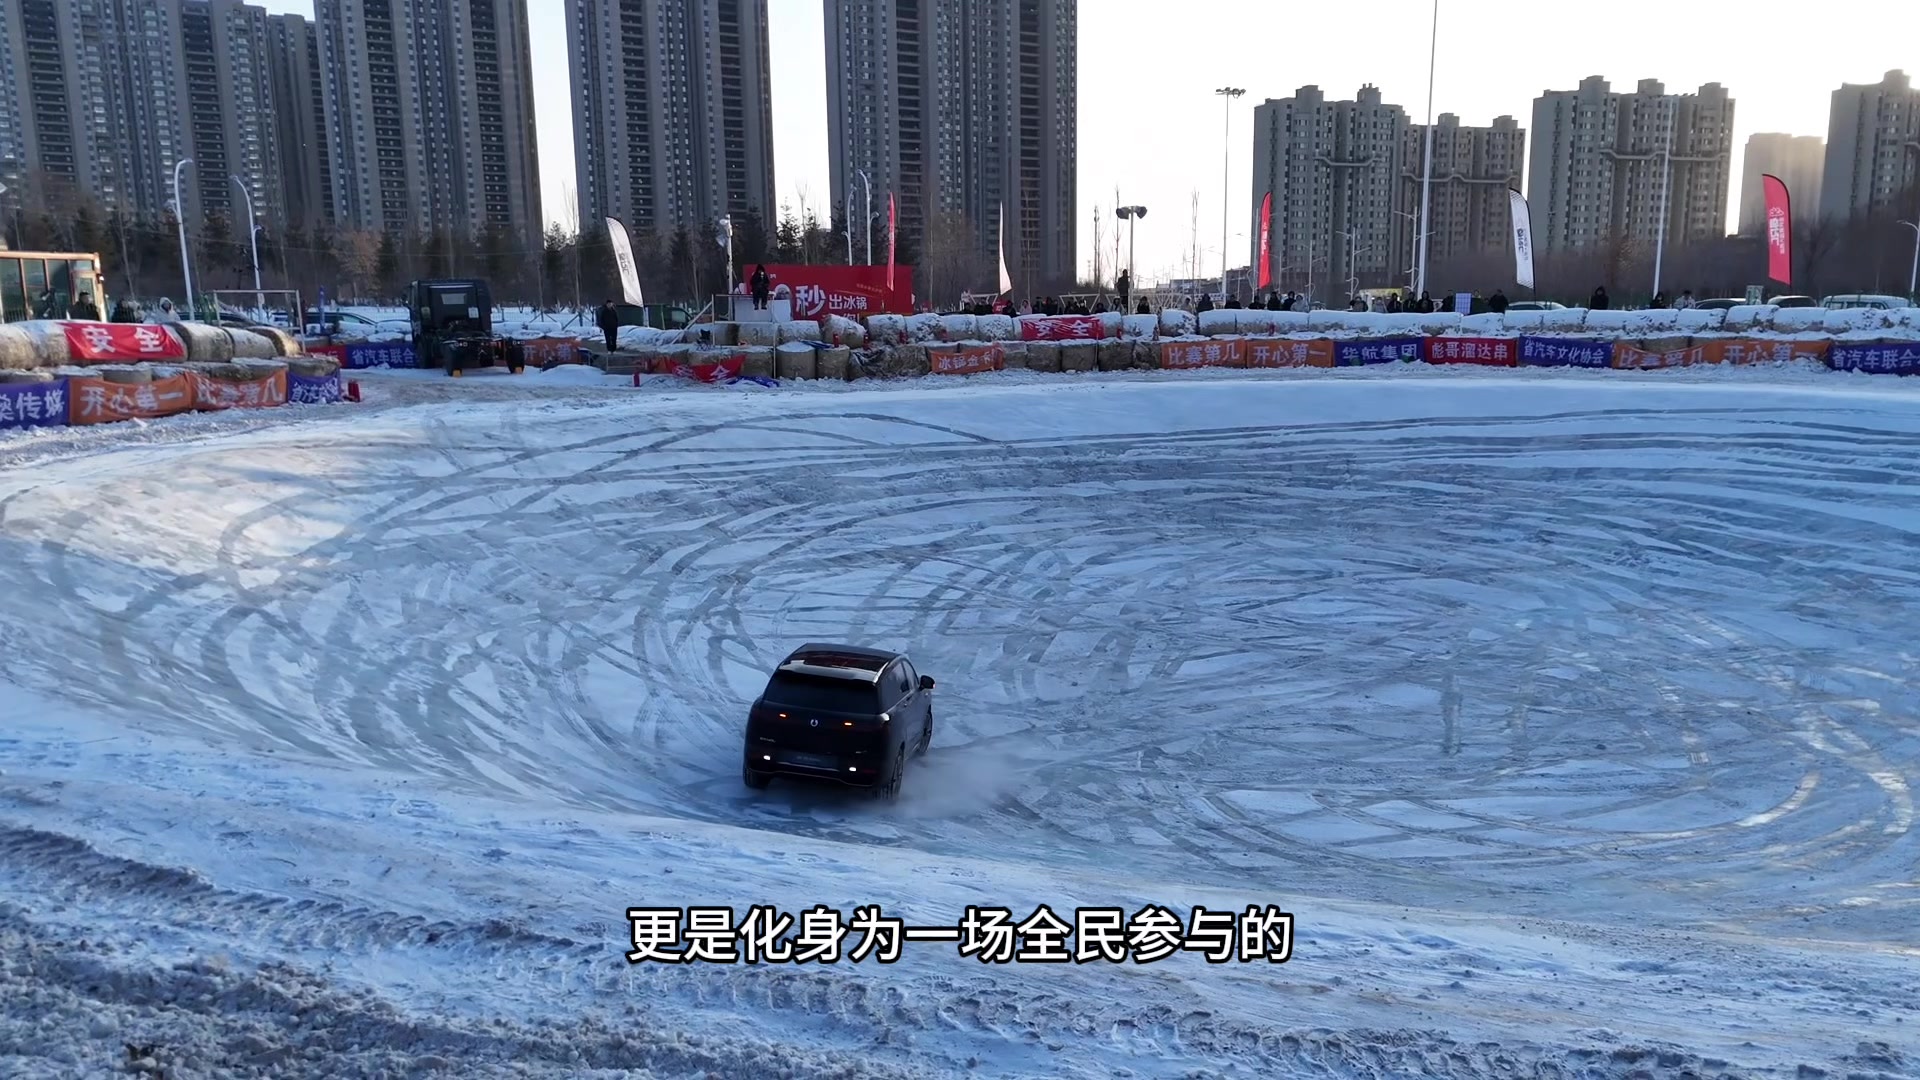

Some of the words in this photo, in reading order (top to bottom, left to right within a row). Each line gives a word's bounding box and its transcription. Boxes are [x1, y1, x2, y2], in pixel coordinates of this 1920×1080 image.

[81, 325, 164, 353] 安全
[352, 348, 419, 365] 省汽车联合
[1168, 342, 1241, 366] 比赛第几
[1253, 342, 1327, 364] 开心第一
[1342, 343, 1418, 360] 华航集团
[1431, 341, 1509, 361] 彪哥溜达串
[1523, 338, 1605, 364] 省汽车文化协会
[1724, 343, 1819, 363] 开心第一
[1832, 348, 1920, 369] 省汽车联合
[80, 385, 184, 416] 开心第一
